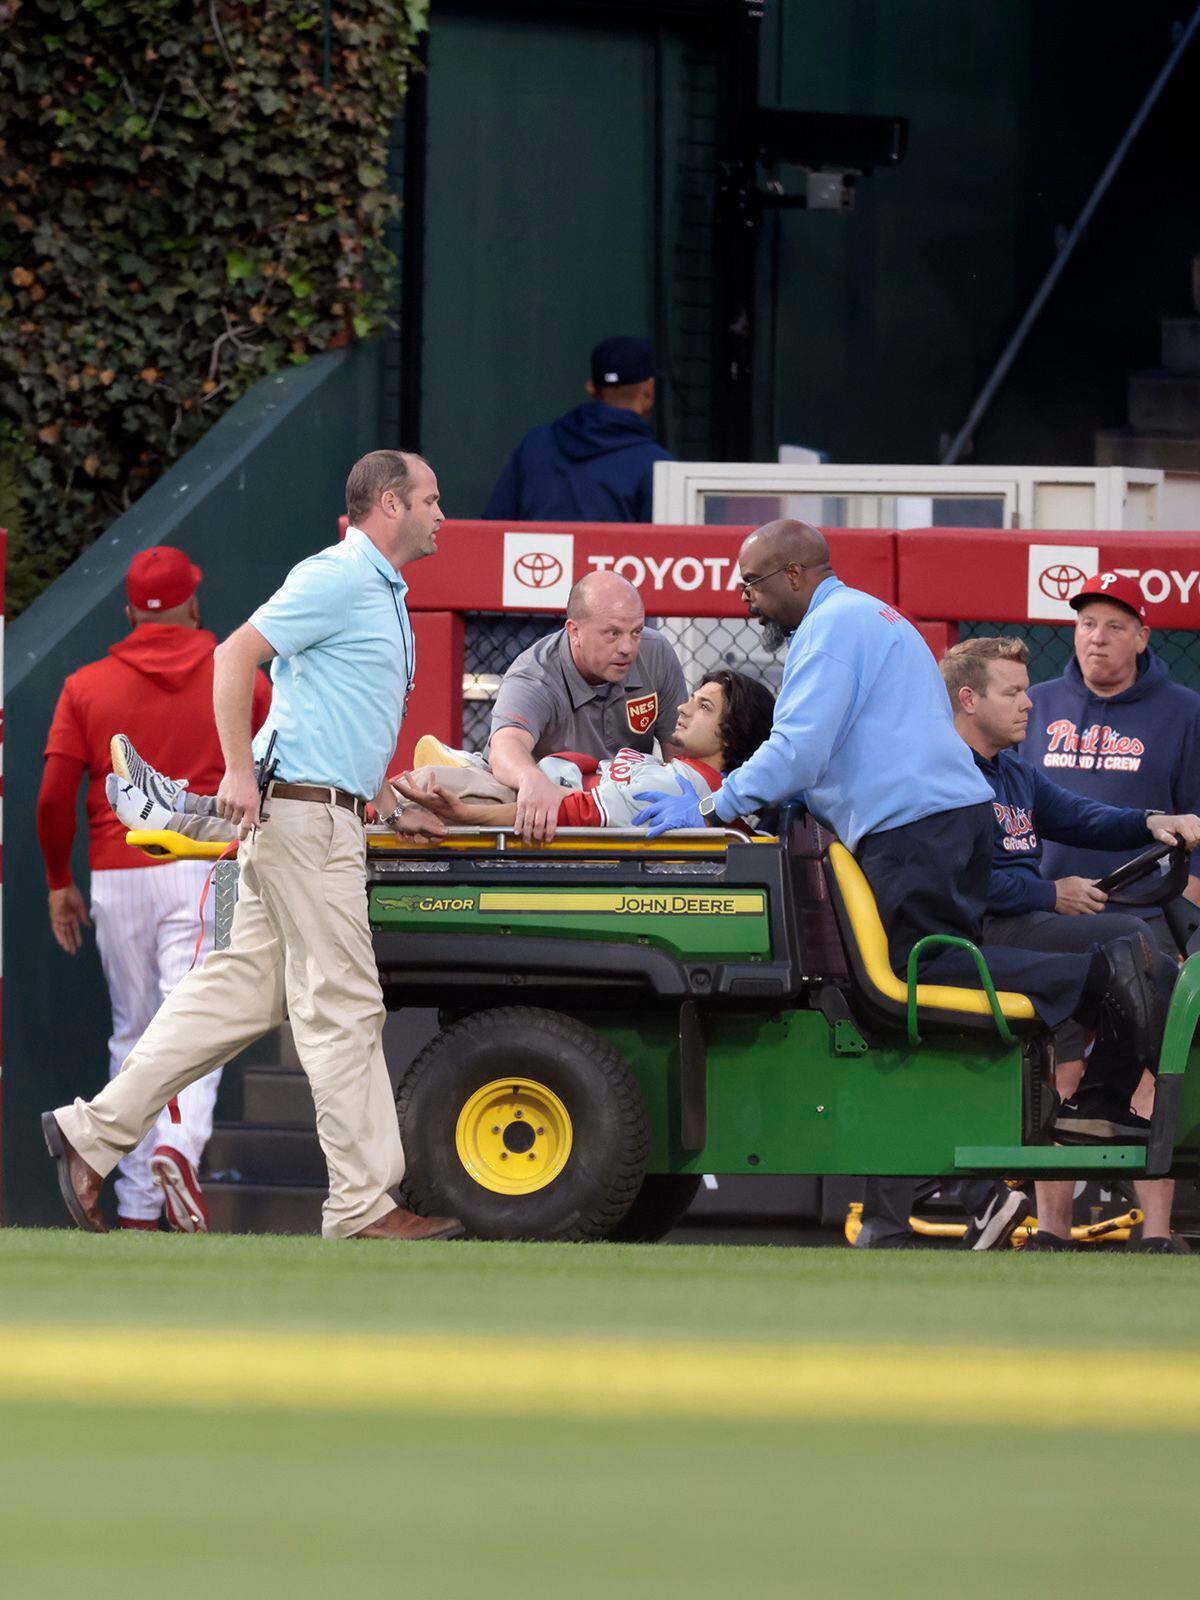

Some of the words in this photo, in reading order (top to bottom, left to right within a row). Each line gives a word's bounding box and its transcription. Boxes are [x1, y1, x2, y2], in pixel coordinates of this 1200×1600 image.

[1100, 573, 1118, 590] P
[629, 700, 655, 717] NES
[1046, 719, 1145, 756] Phillies
[1104, 756, 1142, 771] CREW
[420, 897, 474, 911] GATOR
